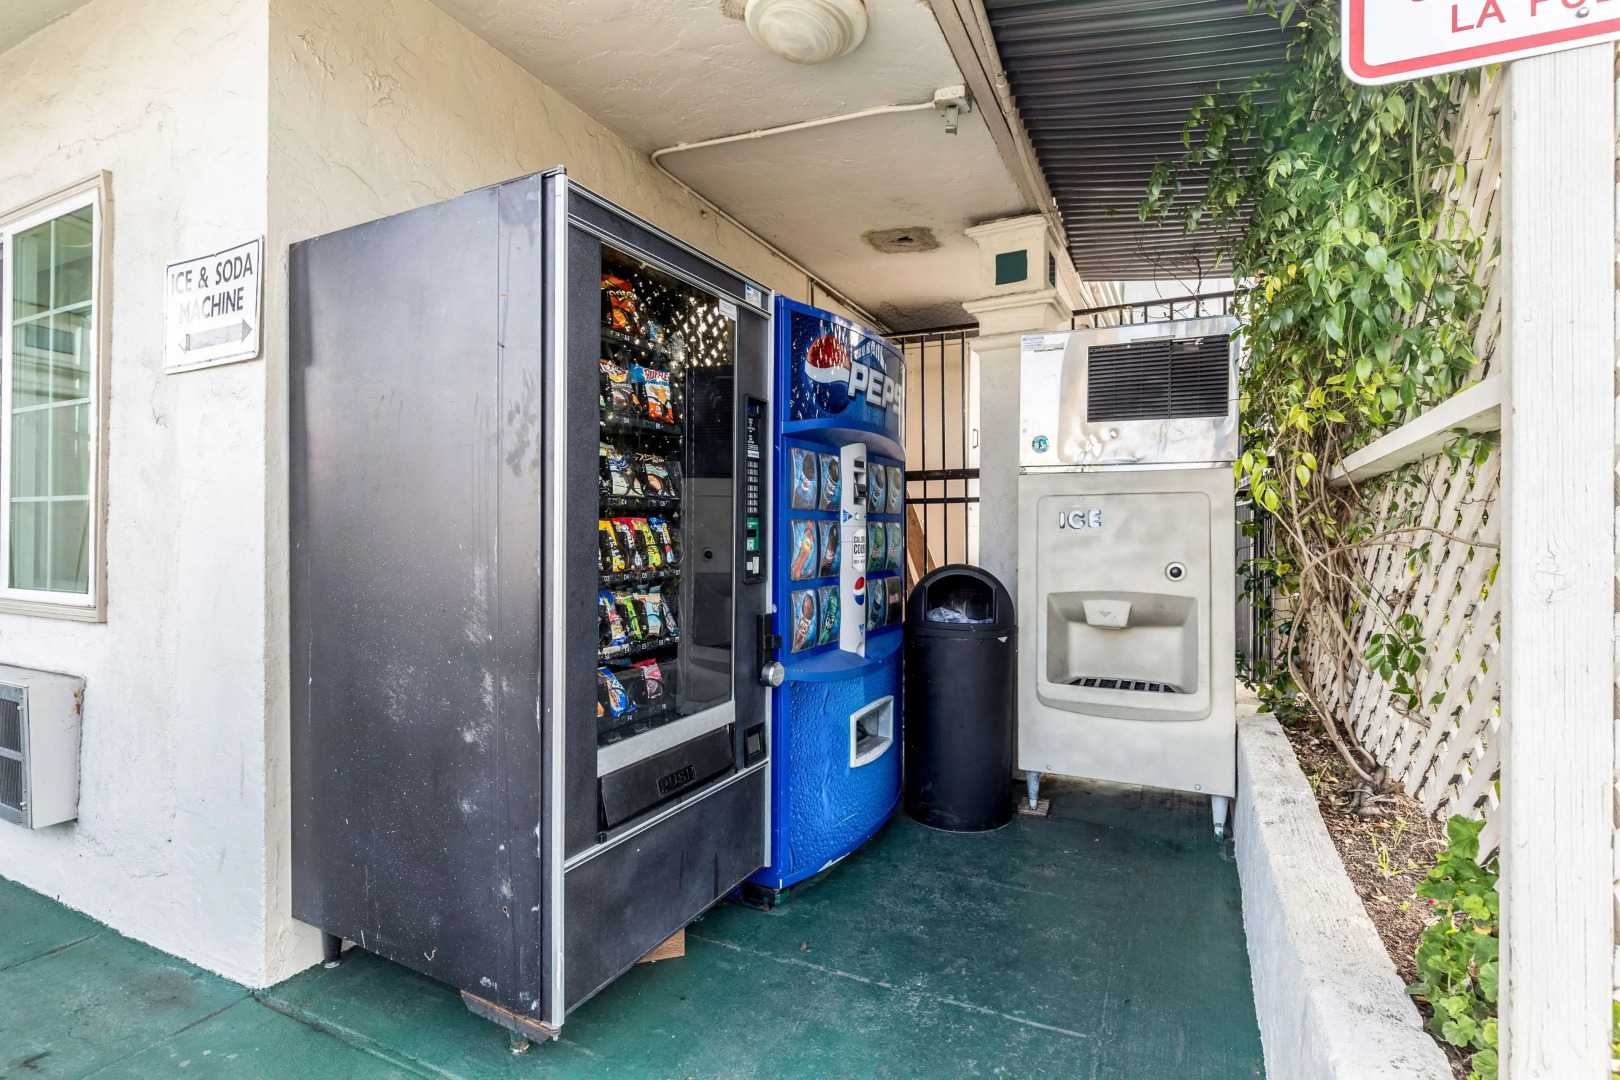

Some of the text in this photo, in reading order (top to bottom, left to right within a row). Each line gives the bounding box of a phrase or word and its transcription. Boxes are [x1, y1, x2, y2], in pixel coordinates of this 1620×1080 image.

[1451, 0, 1506, 33] LA
[171, 253, 253, 295] ICE & SODA
[179, 287, 244, 324] MACHINE
[1059, 509, 1102, 530] ICE
[661, 766, 695, 793] PUSH
